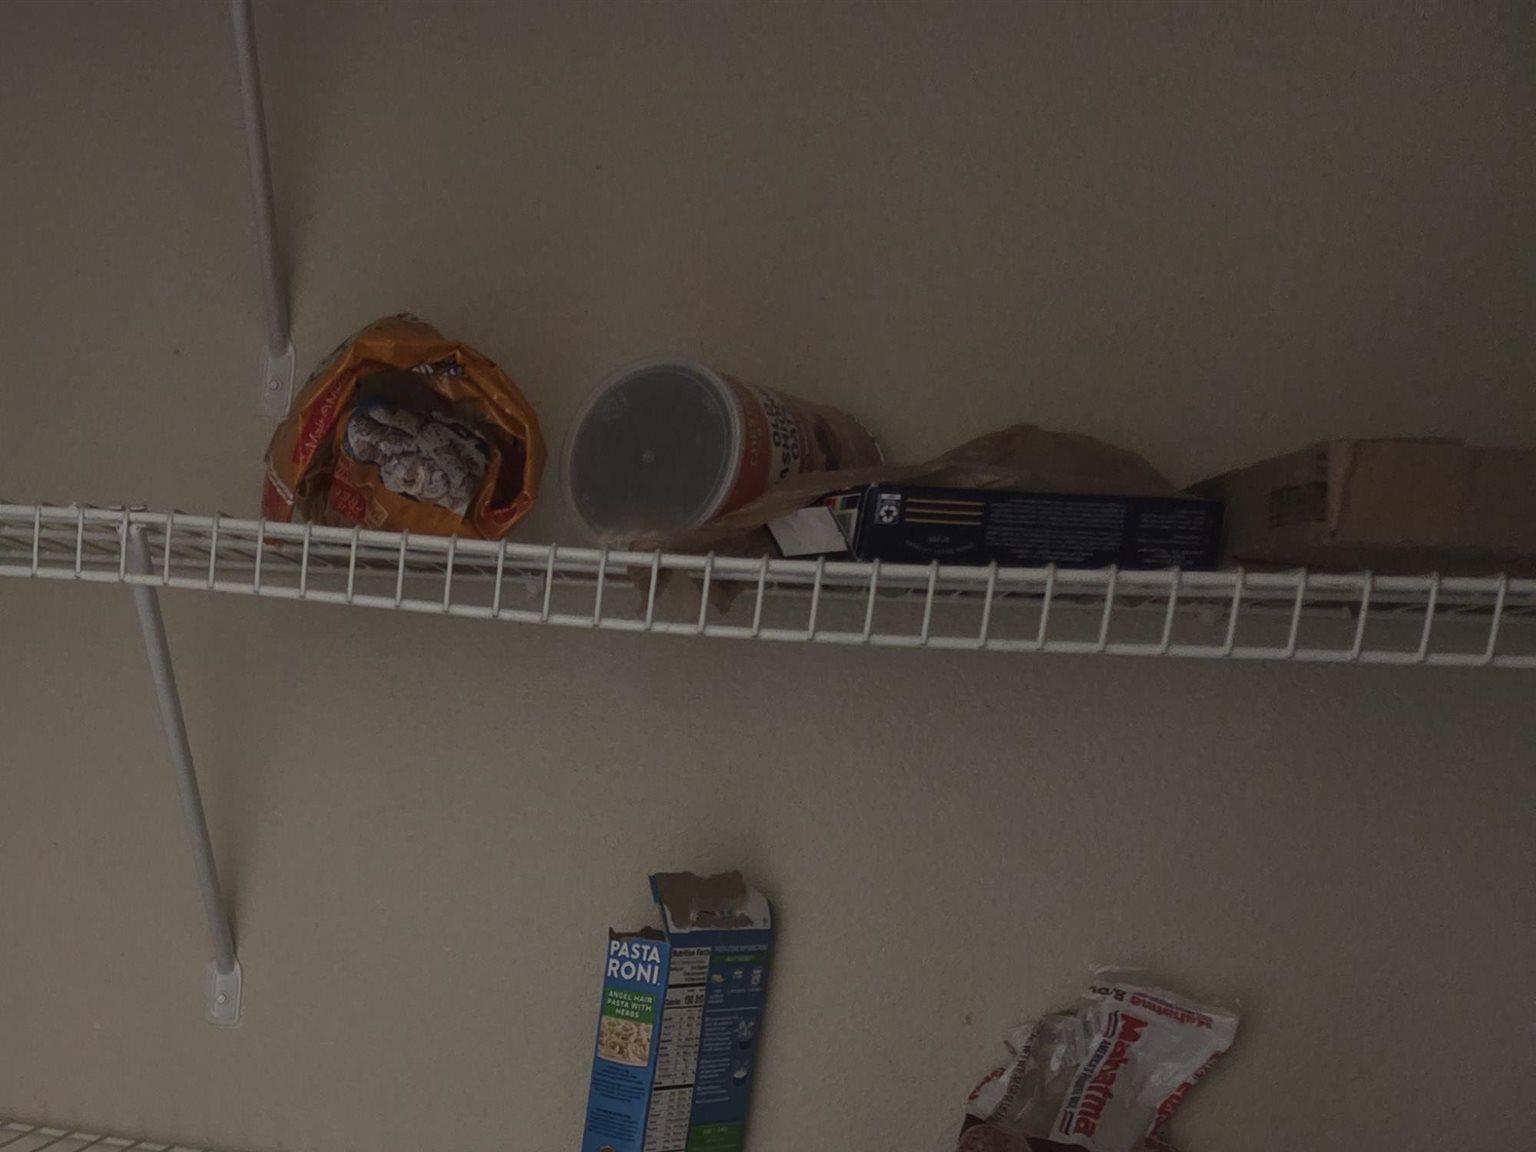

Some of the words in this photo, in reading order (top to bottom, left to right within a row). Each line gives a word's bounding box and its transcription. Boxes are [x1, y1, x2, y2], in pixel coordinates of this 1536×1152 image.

[609, 940, 661, 964] PASTA
[607, 959, 660, 985] RONI
[607, 998, 630, 1010] PASTA
[631, 1001, 653, 1013] WITH
[608, 990, 632, 1004] ANGEL
[1075, 1013, 1148, 1138] Mahatma
